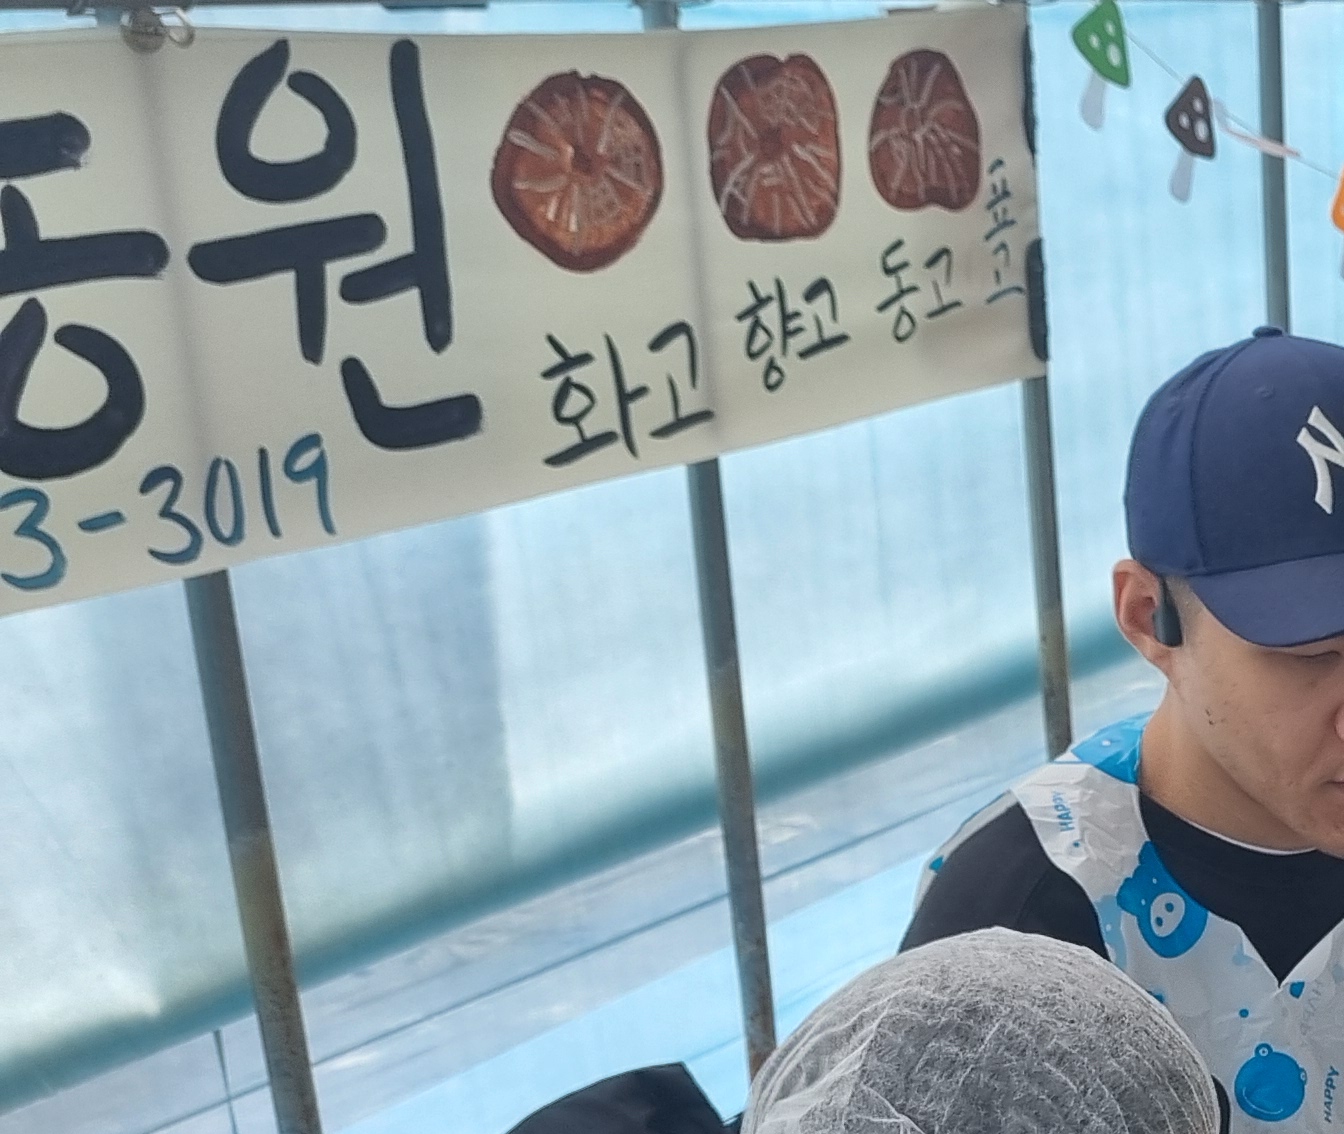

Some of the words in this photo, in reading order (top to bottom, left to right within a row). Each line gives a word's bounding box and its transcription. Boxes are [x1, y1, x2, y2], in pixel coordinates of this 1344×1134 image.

[541, 319, 715, 468] 화고
[734, 275, 850, 393] 향고
[876, 238, 963, 344] 동고
[1051, 790, 1075, 832] HAPPY
[1324, 1065, 1340, 1123] HAPPY
